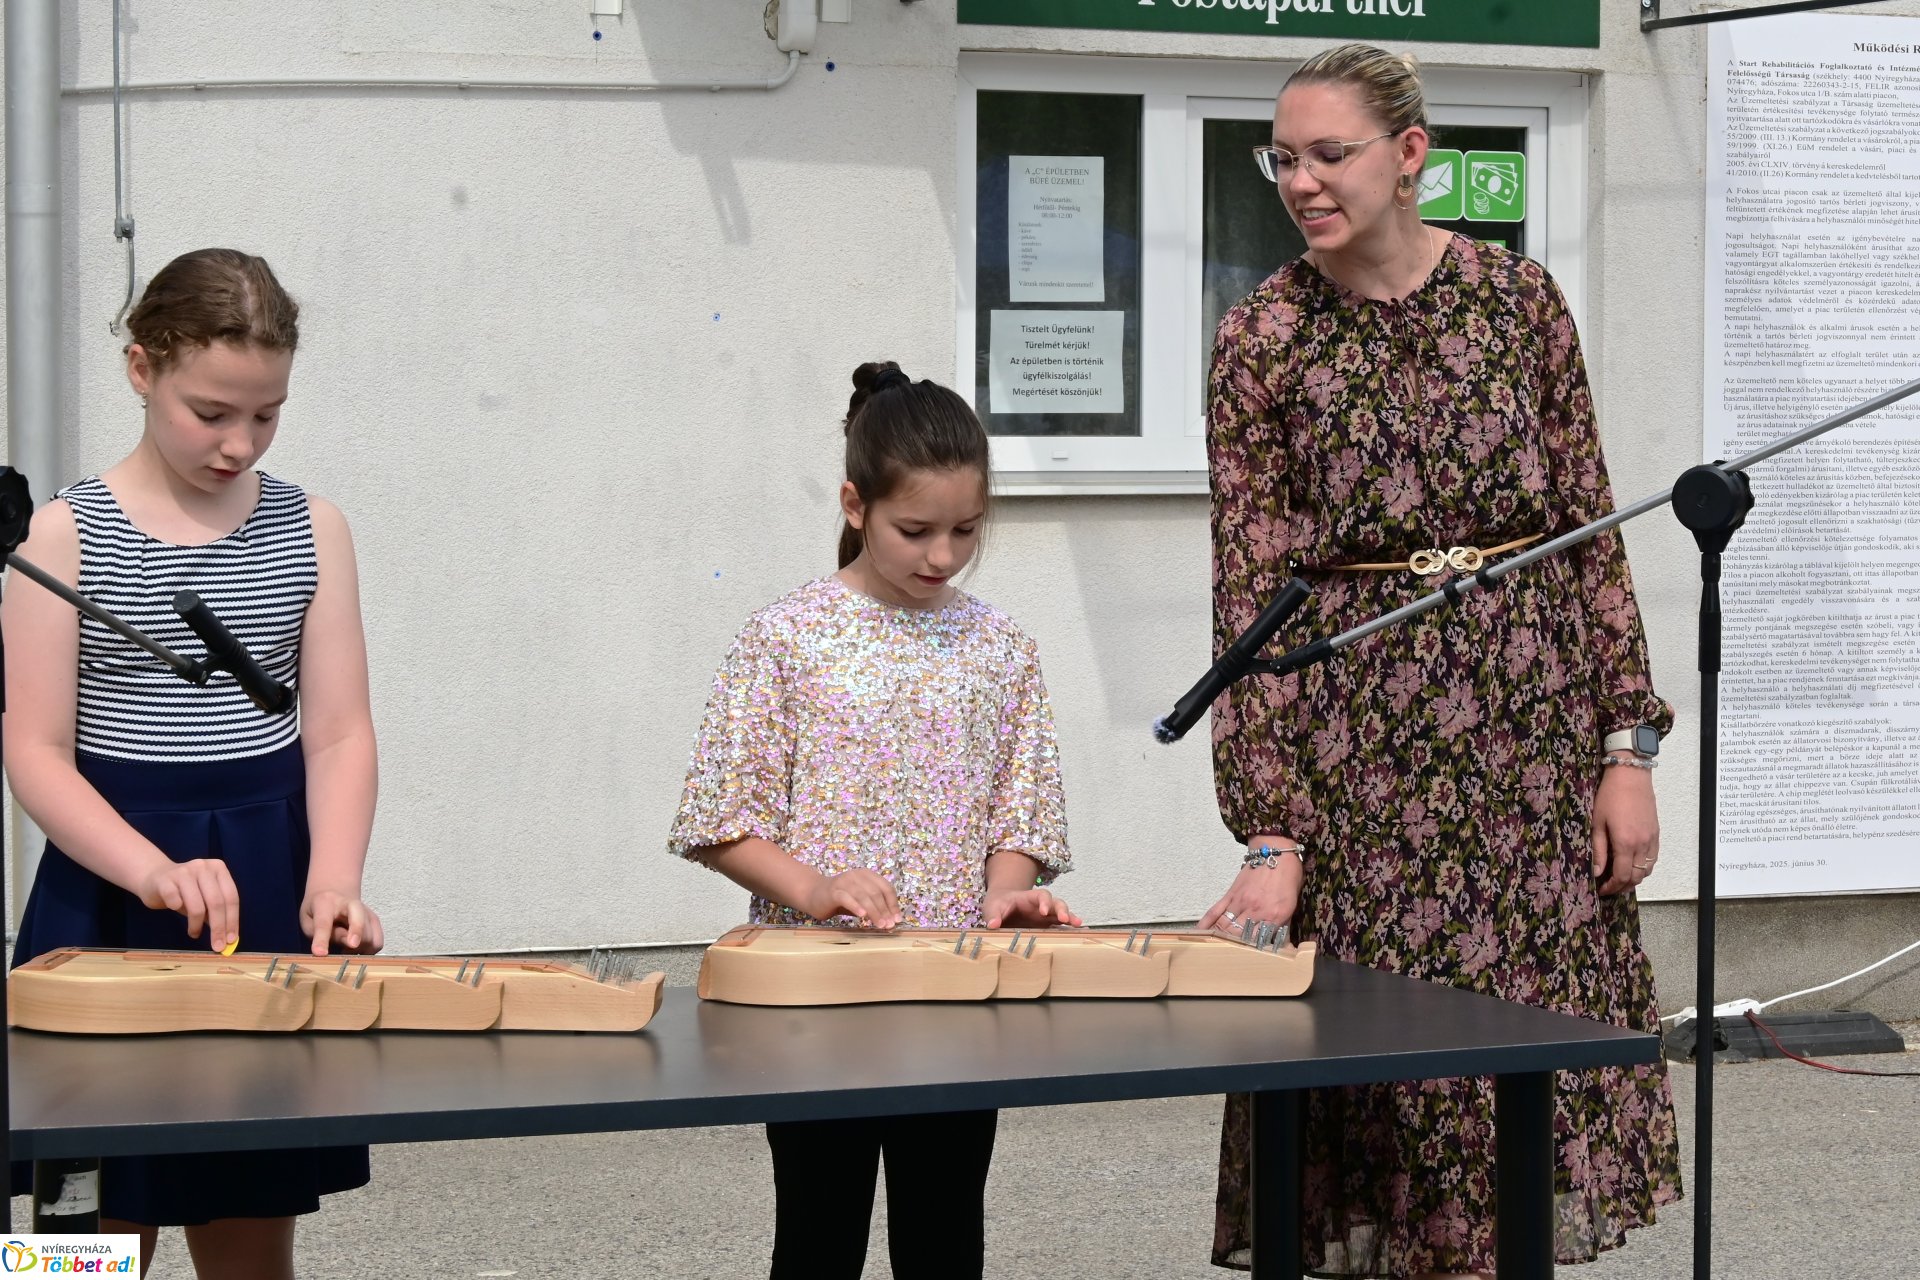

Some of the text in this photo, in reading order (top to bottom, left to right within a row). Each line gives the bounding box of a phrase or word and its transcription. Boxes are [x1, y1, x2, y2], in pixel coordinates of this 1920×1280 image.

[1853, 42, 1909, 53] Működési
[1820, 62, 1873, 72] Foglalkoztató
[1728, 70, 1771, 79] Felelősségű
[1775, 71, 1810, 81] Társaság
[1834, 90, 1853, 98] szám
[1873, 92, 1899, 101] piacon,
[1741, 96, 1789, 105] Üzemeltetési
[1793, 98, 1830, 108] szabályzat
[1843, 100, 1874, 109] Társaság
[1818, 144, 1848, 152] rendelet
[1860, 145, 1884, 154] vásári,
[1887, 146, 1905, 155] piaci
[1726, 151, 1771, 160] szabályairól
[1046, 166, 1089, 176] ÉPÜLETBEN
[1030, 176, 1085, 185] BÜFÉ ÜZEMEL!
[1784, 189, 1808, 197] piacon
[1726, 196, 1783, 206] helyhasználatra
[1786, 197, 1816, 206] jogosító
[1870, 199, 1911, 208] jogviszony,
[1725, 233, 1744, 241] Napi
[1750, 233, 1801, 242] helyhasználat
[1852, 235, 1906, 244] igénybevételre
[1724, 296, 1762, 305] személyes
[1858, 297, 1896, 305] közérdekű
[1724, 305, 1772, 314] megfelelően,
[1775, 305, 1804, 314] amelyet
[1815, 306, 1830, 314] piac
[1021, 324, 1095, 335] Tisztelt Ügyfelünk!
[1734, 323, 1750, 332] napi
[1753, 324, 1806, 332] helyhasználók
[1816, 333, 1867, 342] jogviszonnyal
[1025, 341, 1090, 350] Türelmét kérjük!
[1735, 351, 1751, 359] napi
[1756, 351, 1814, 359] helyhasználatért
[1010, 357, 1104, 366] Az épületben is történik
[1023, 371, 1092, 381] ügyfélkiszolgálás!
[1012, 387, 1102, 397] Megértését köszönjük!
[1806, 456, 1874, 465] helyen folytatható,
[1824, 535, 1875, 544] kötelezettsége
[1878, 535, 1918, 544] folyamatos
[1733, 589, 1751, 597] piaci
[1805, 588, 1843, 597] szabályzat
[1847, 587, 1893, 596] szabályainak
[1722, 597, 1775, 606] helyhasználati
[1781, 597, 1814, 606] engedély
[1821, 596, 1875, 604] visszavonására
[1732, 703, 1781, 712] helyhasználó
[1816, 701, 1864, 710] tevékenysége
[1869, 700, 1889, 708] során
[1720, 712, 1761, 721] megtartani.
[1720, 756, 1756, 765] szükséges
[1762, 755, 1802, 764] megőrizni,
[1839, 753, 1860, 761] börze
[1865, 753, 1883, 762] ideje
[1792, 860, 1814, 869] június
[1817, 859, 1827, 867] 30.
